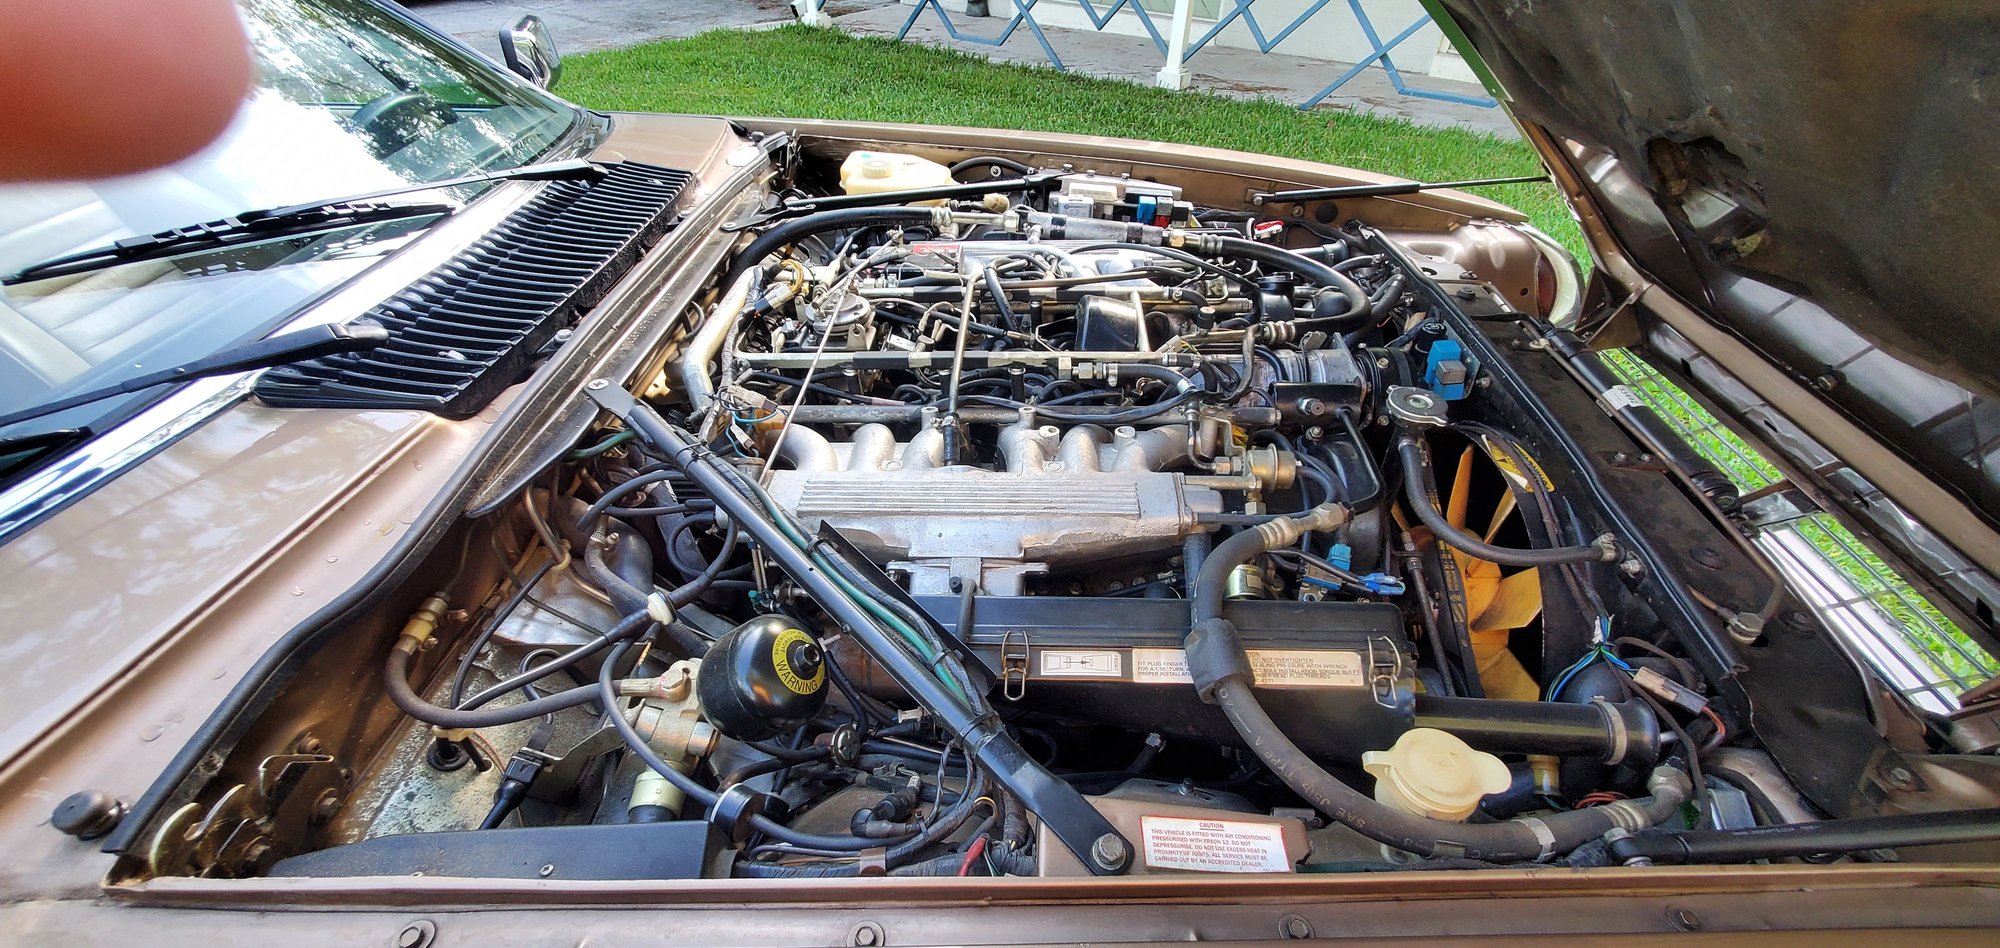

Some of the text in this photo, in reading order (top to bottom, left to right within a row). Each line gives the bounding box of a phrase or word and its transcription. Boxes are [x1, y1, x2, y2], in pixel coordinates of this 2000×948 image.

[776, 659, 818, 692] WARNING
[1264, 751, 1295, 781] TYPE
[1336, 807, 1365, 828] SAE
